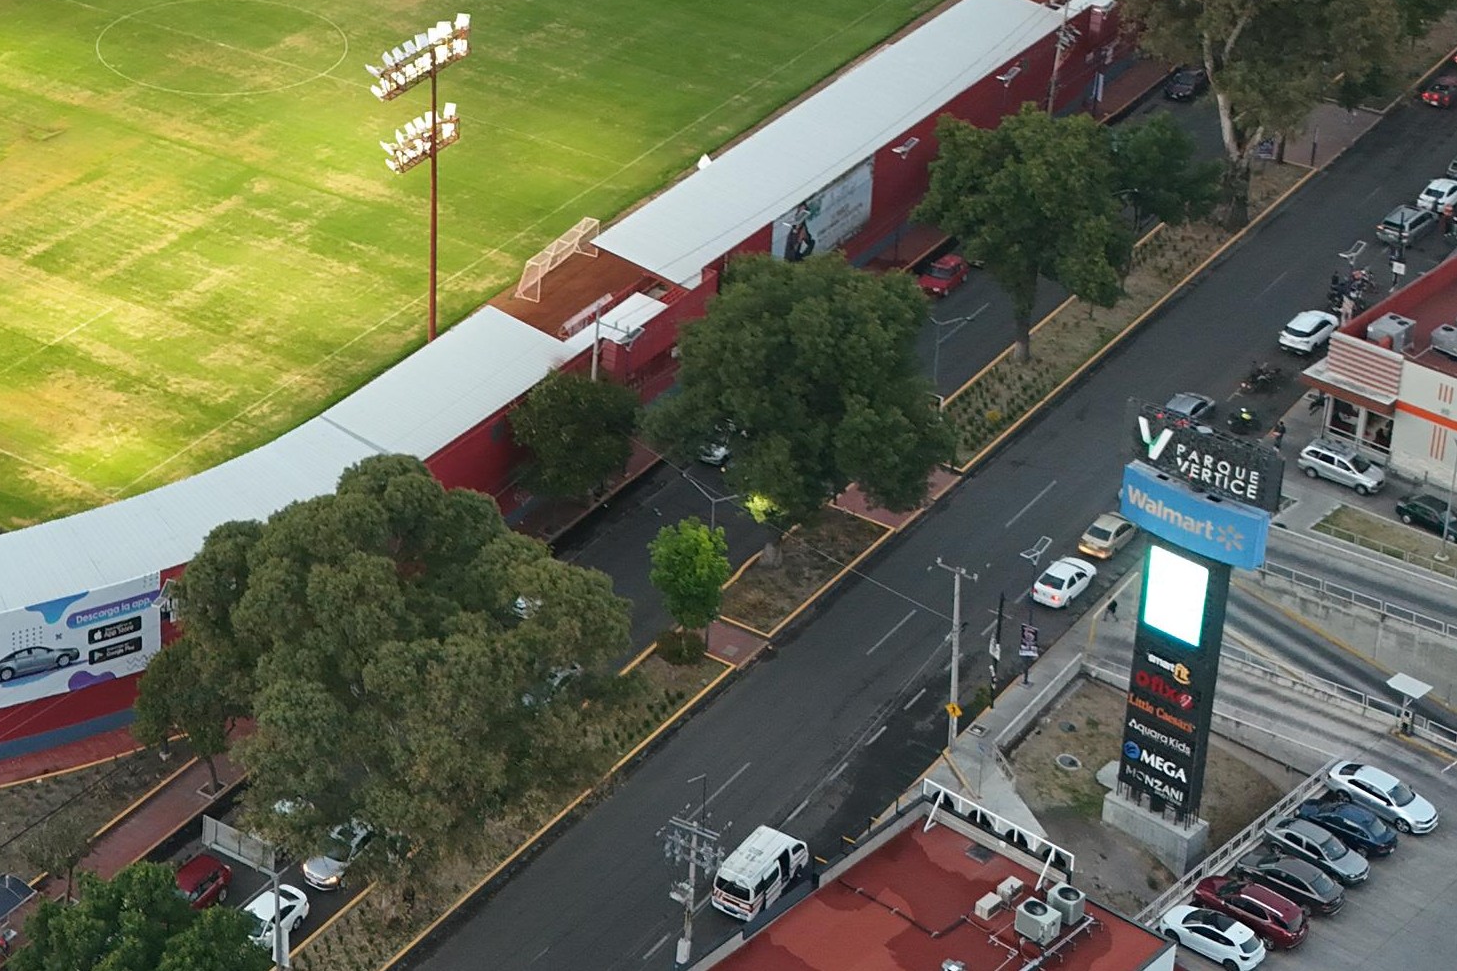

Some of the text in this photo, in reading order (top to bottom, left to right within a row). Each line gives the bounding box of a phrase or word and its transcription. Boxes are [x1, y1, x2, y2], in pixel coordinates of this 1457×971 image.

[1177, 444, 1259, 485] PARQUE
[1128, 484, 1214, 540] Walmart
[76, 605, 120, 624] Descarga
[121, 602, 131, 611] la
[1128, 718, 1191, 757] Aquara Kids
[1125, 764, 1184, 802] MONZANI
[1140, 749, 1187, 784] MEGA
